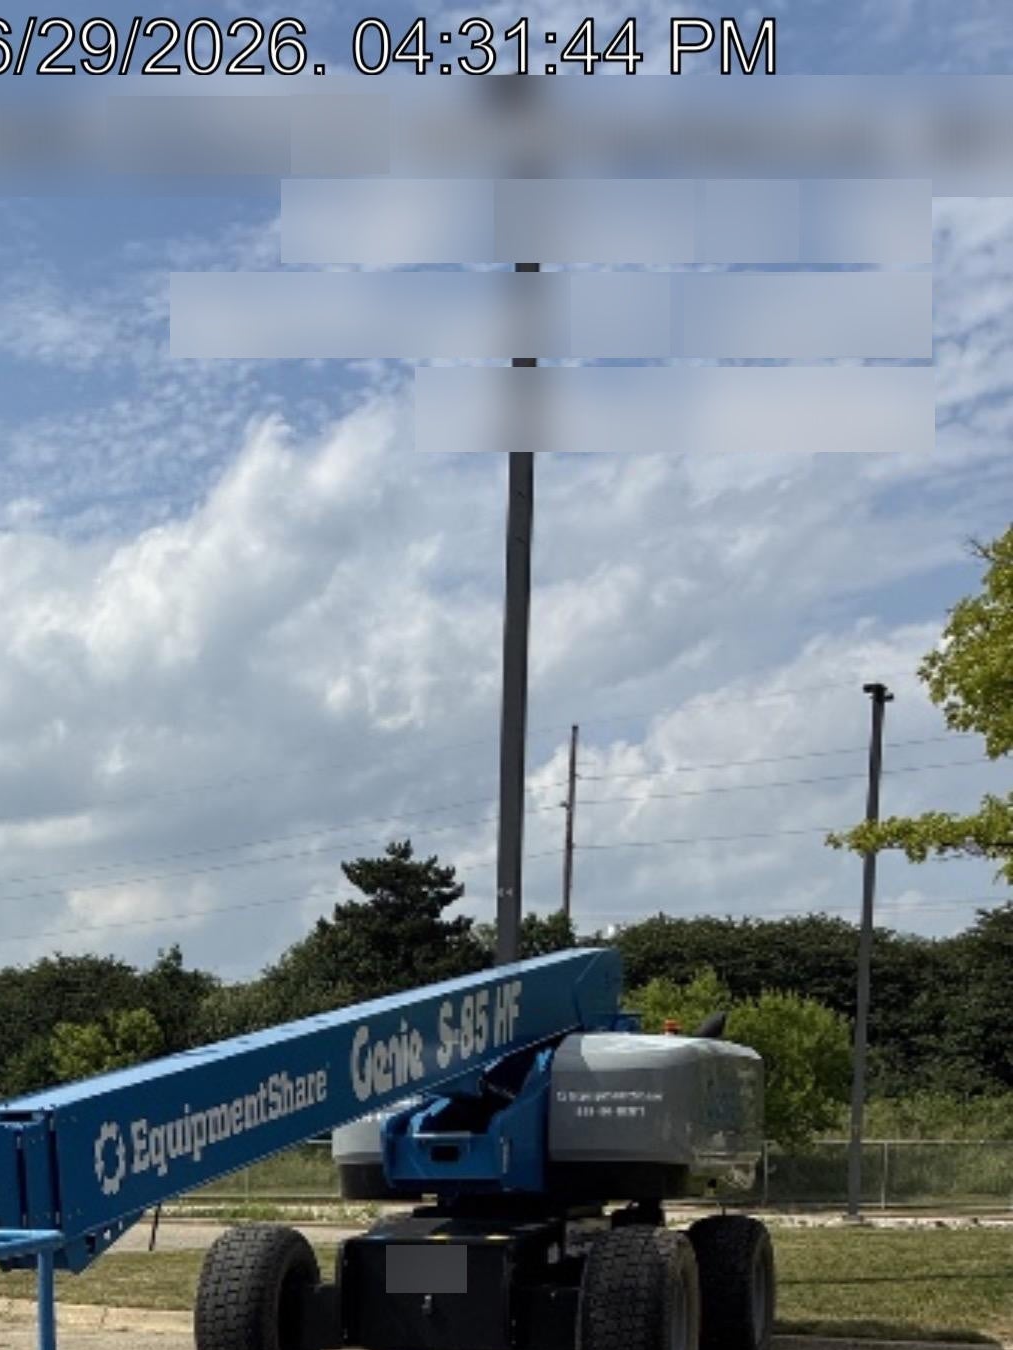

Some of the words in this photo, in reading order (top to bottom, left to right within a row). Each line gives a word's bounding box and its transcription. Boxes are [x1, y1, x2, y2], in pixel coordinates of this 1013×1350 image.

[349, 1018, 425, 1101] Genie
[435, 990, 489, 1069] S-85
[493, 980, 523, 1048] HF
[130, 1071, 328, 1178] EquipmentShare
